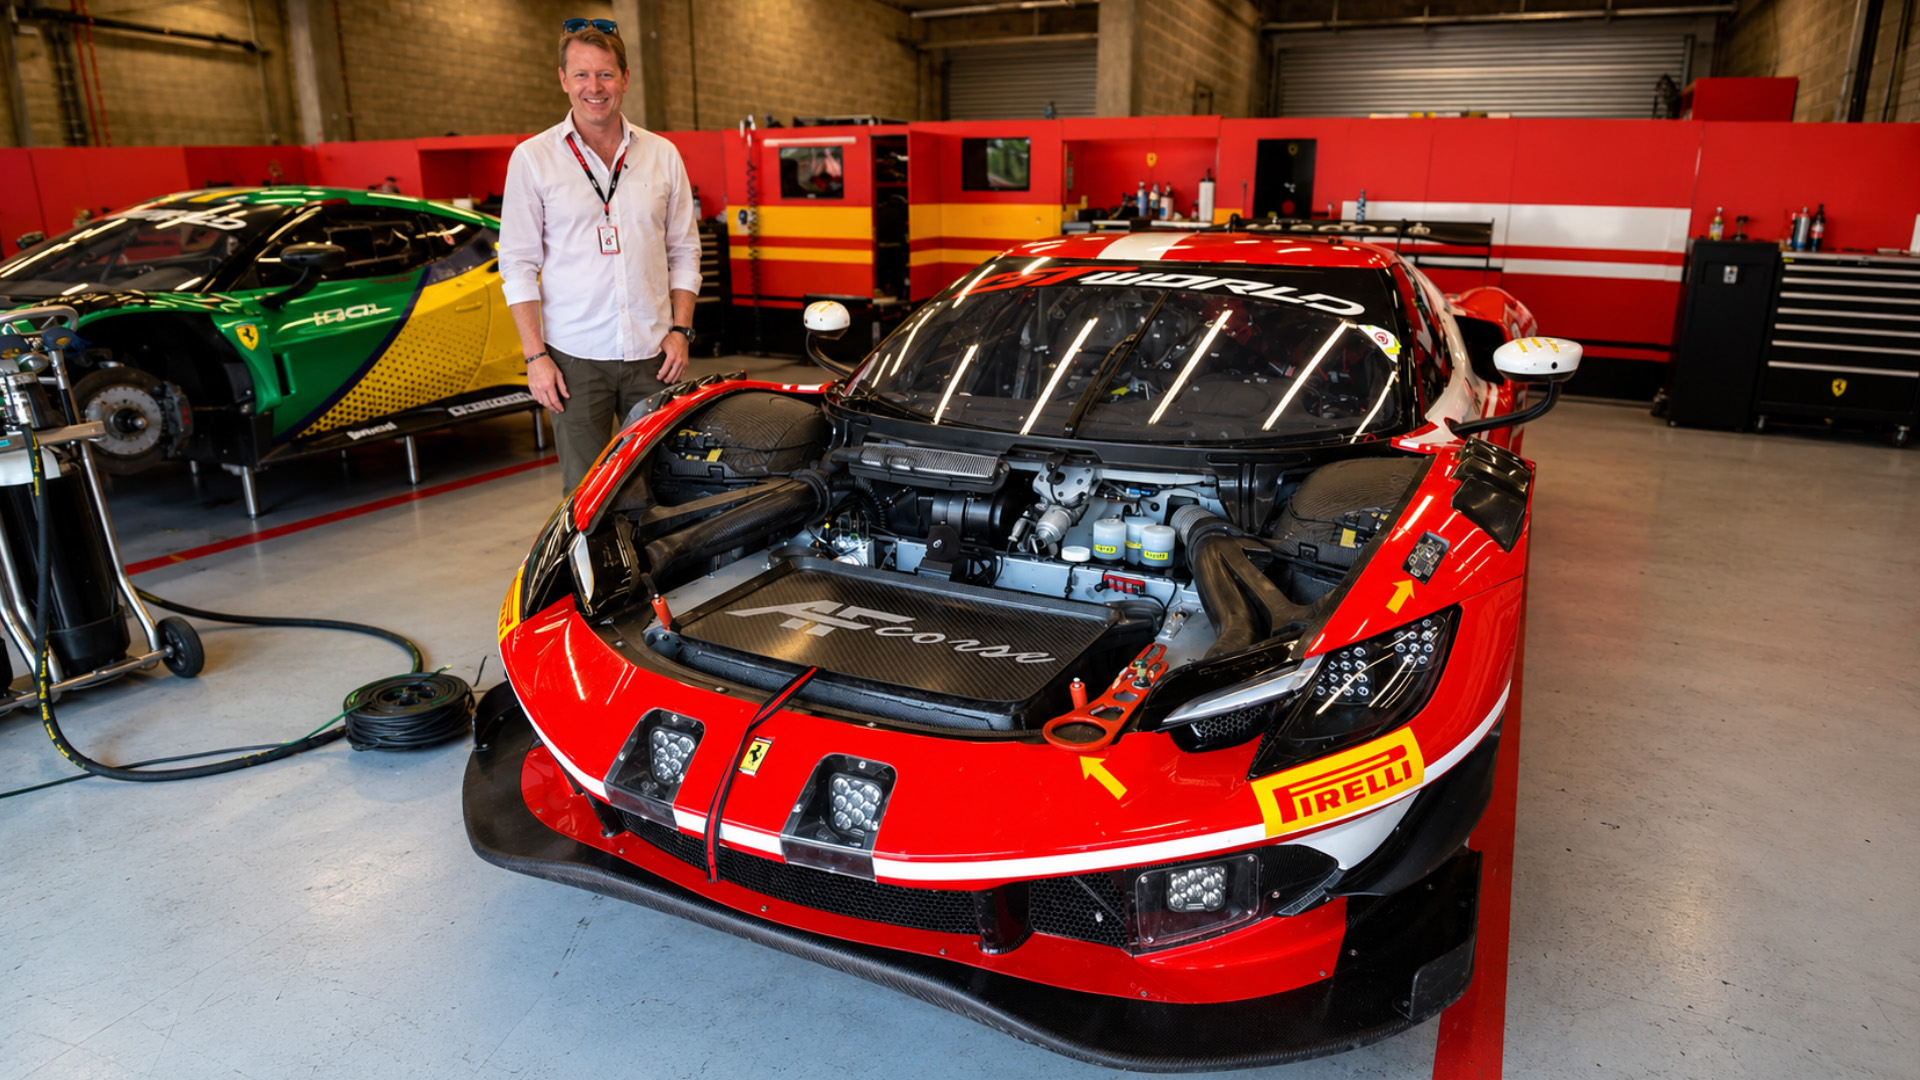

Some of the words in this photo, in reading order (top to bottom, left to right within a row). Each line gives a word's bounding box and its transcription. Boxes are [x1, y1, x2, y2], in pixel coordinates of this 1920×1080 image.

[1078, 271, 1365, 316] WORLD
[725, 599, 916, 637] AF
[875, 626, 1056, 664] corse
[1272, 744, 1412, 825] PIRELLI
